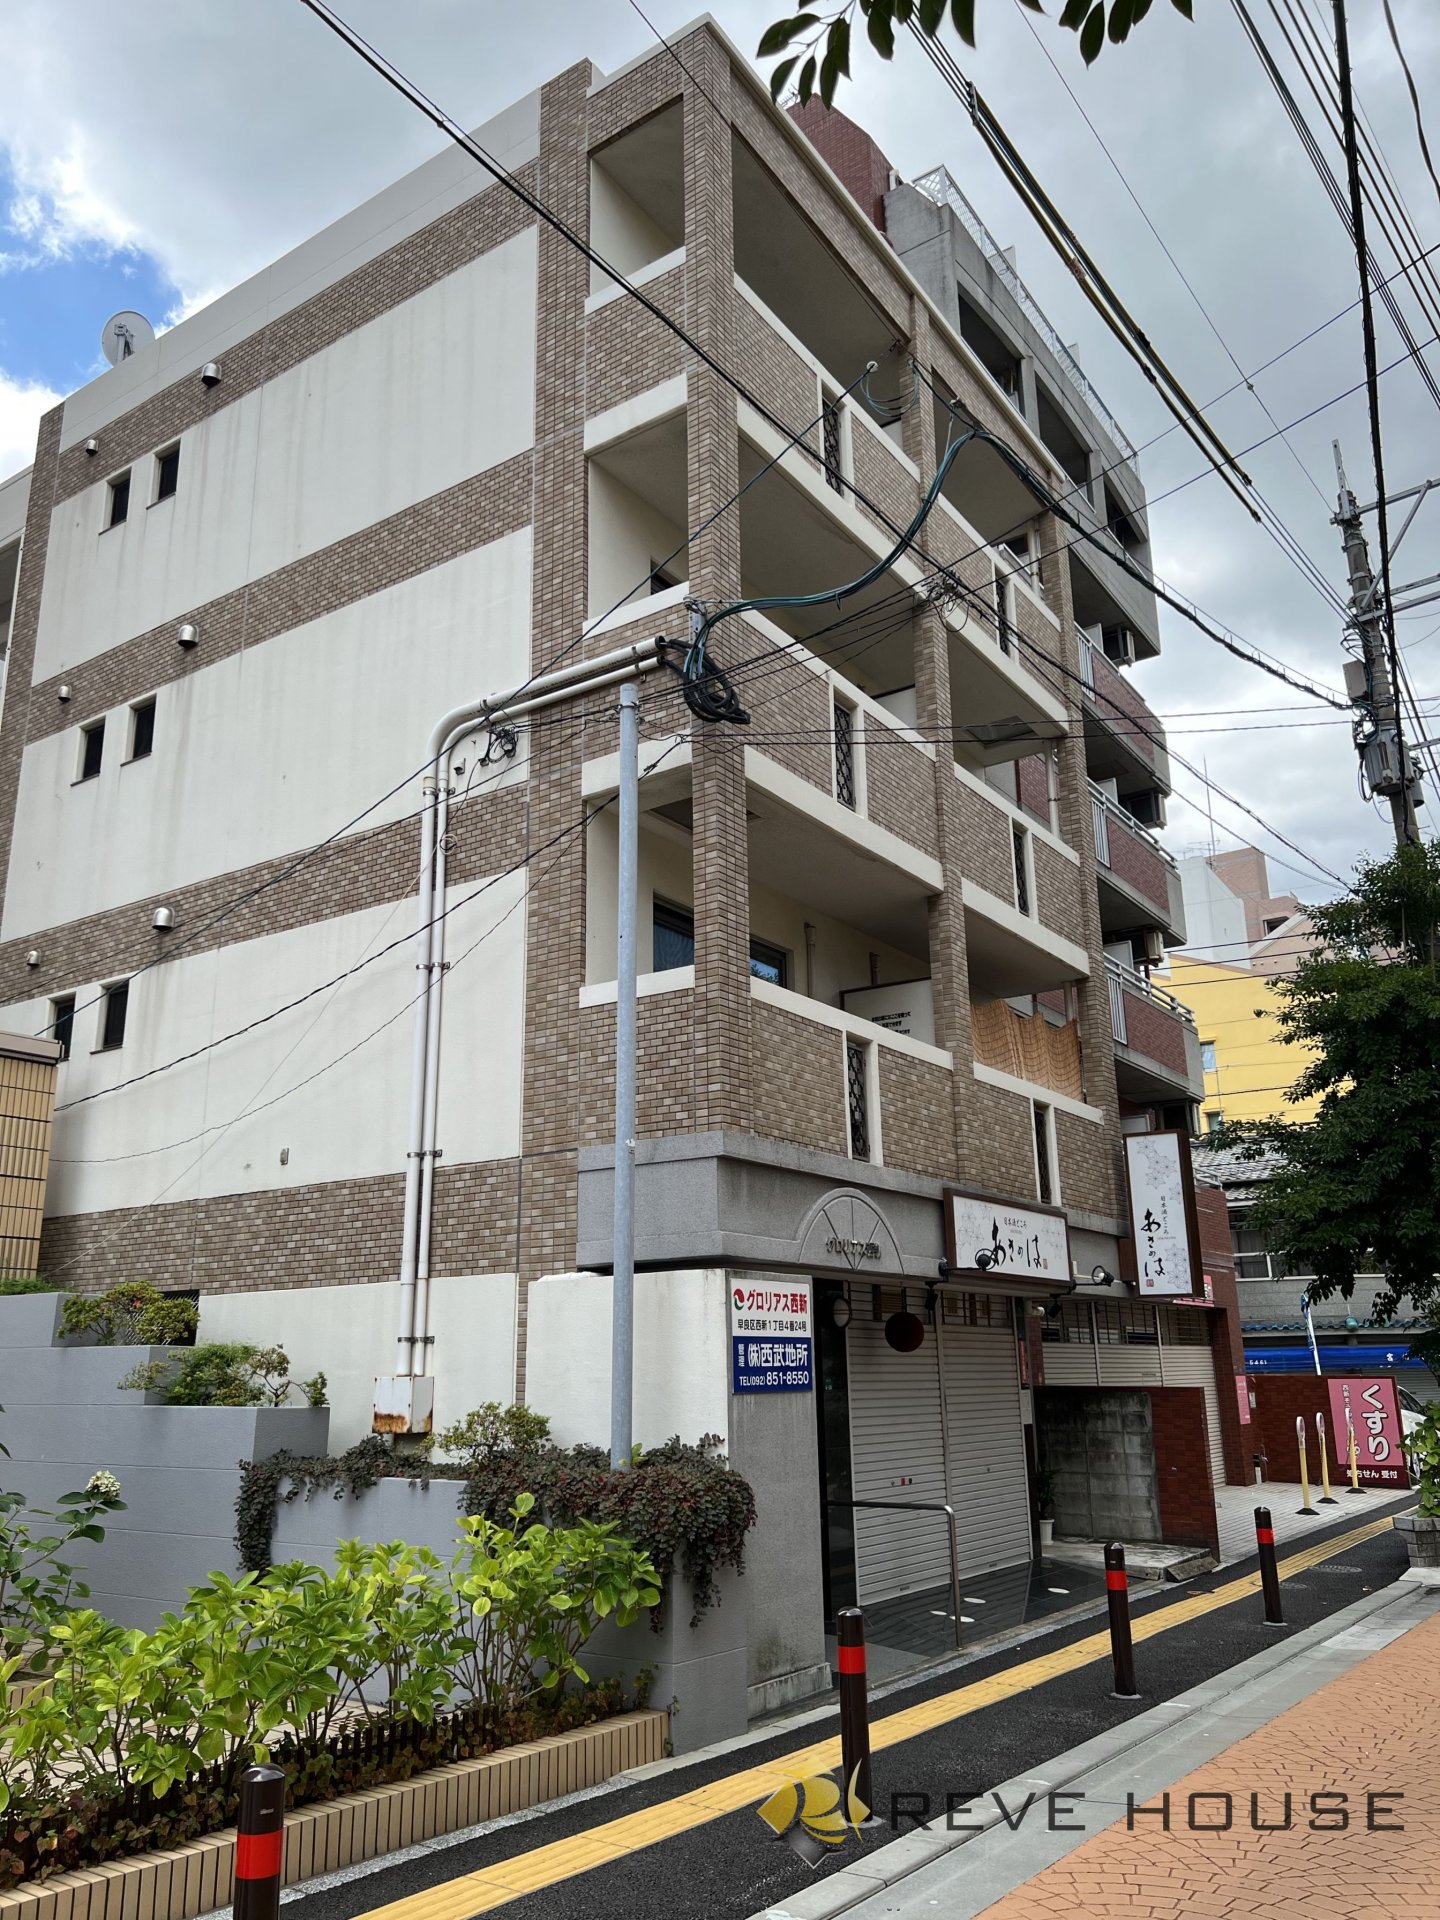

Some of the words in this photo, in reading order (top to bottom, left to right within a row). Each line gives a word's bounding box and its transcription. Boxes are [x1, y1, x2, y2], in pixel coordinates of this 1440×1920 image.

[747, 1289, 808, 1315] グロリアス西新
[1361, 1383, 1390, 1462] くすり
